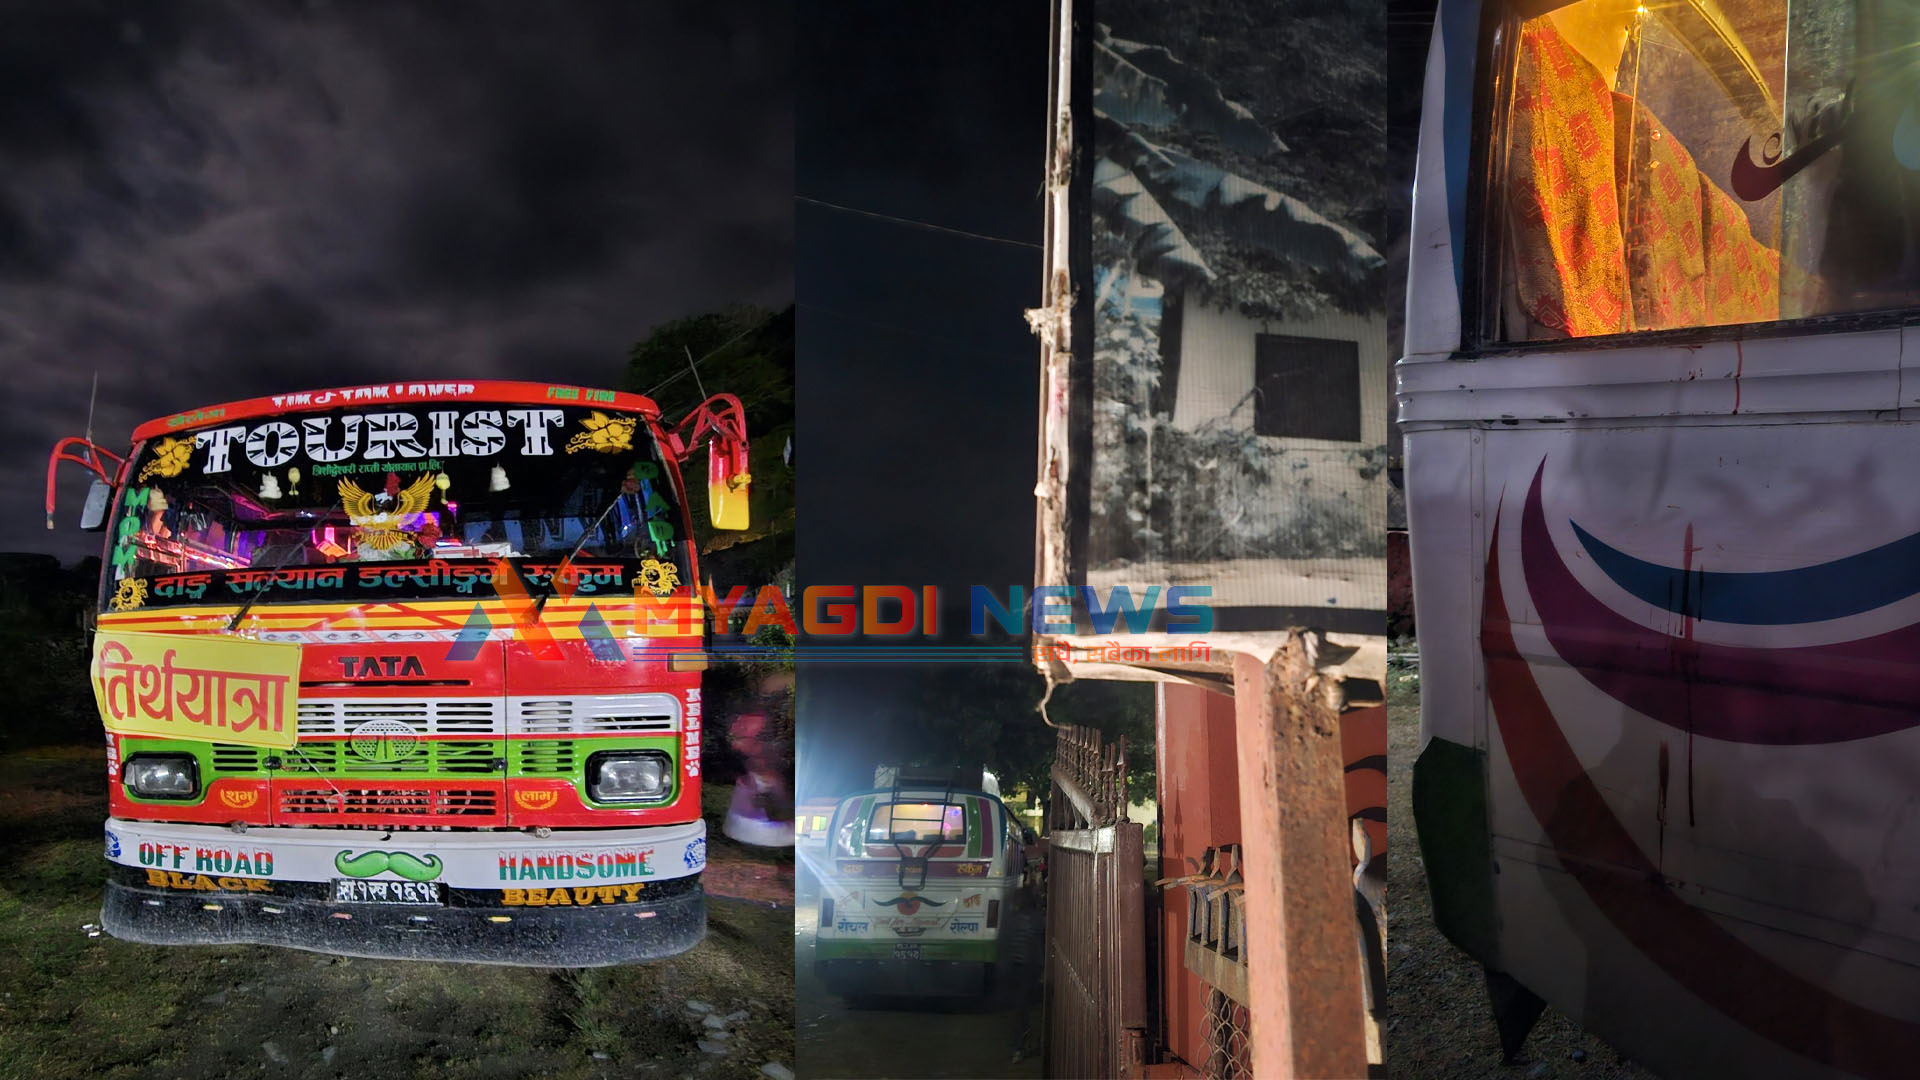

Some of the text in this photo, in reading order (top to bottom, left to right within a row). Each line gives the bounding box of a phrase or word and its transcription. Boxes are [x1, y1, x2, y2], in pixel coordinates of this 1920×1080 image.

[195, 409, 565, 475] TOURIST
[225, 567, 347, 594] सल्यान
[338, 655, 425, 677] TATA
[98, 640, 290, 733] तिर्थयात्रा
[521, 790, 552, 800] लाभ
[138, 841, 275, 876] OFF ROAD
[498, 847, 656, 881] HANDSOME
[146, 869, 274, 892] BLACK
[501, 883, 645, 906] BEAUTY
